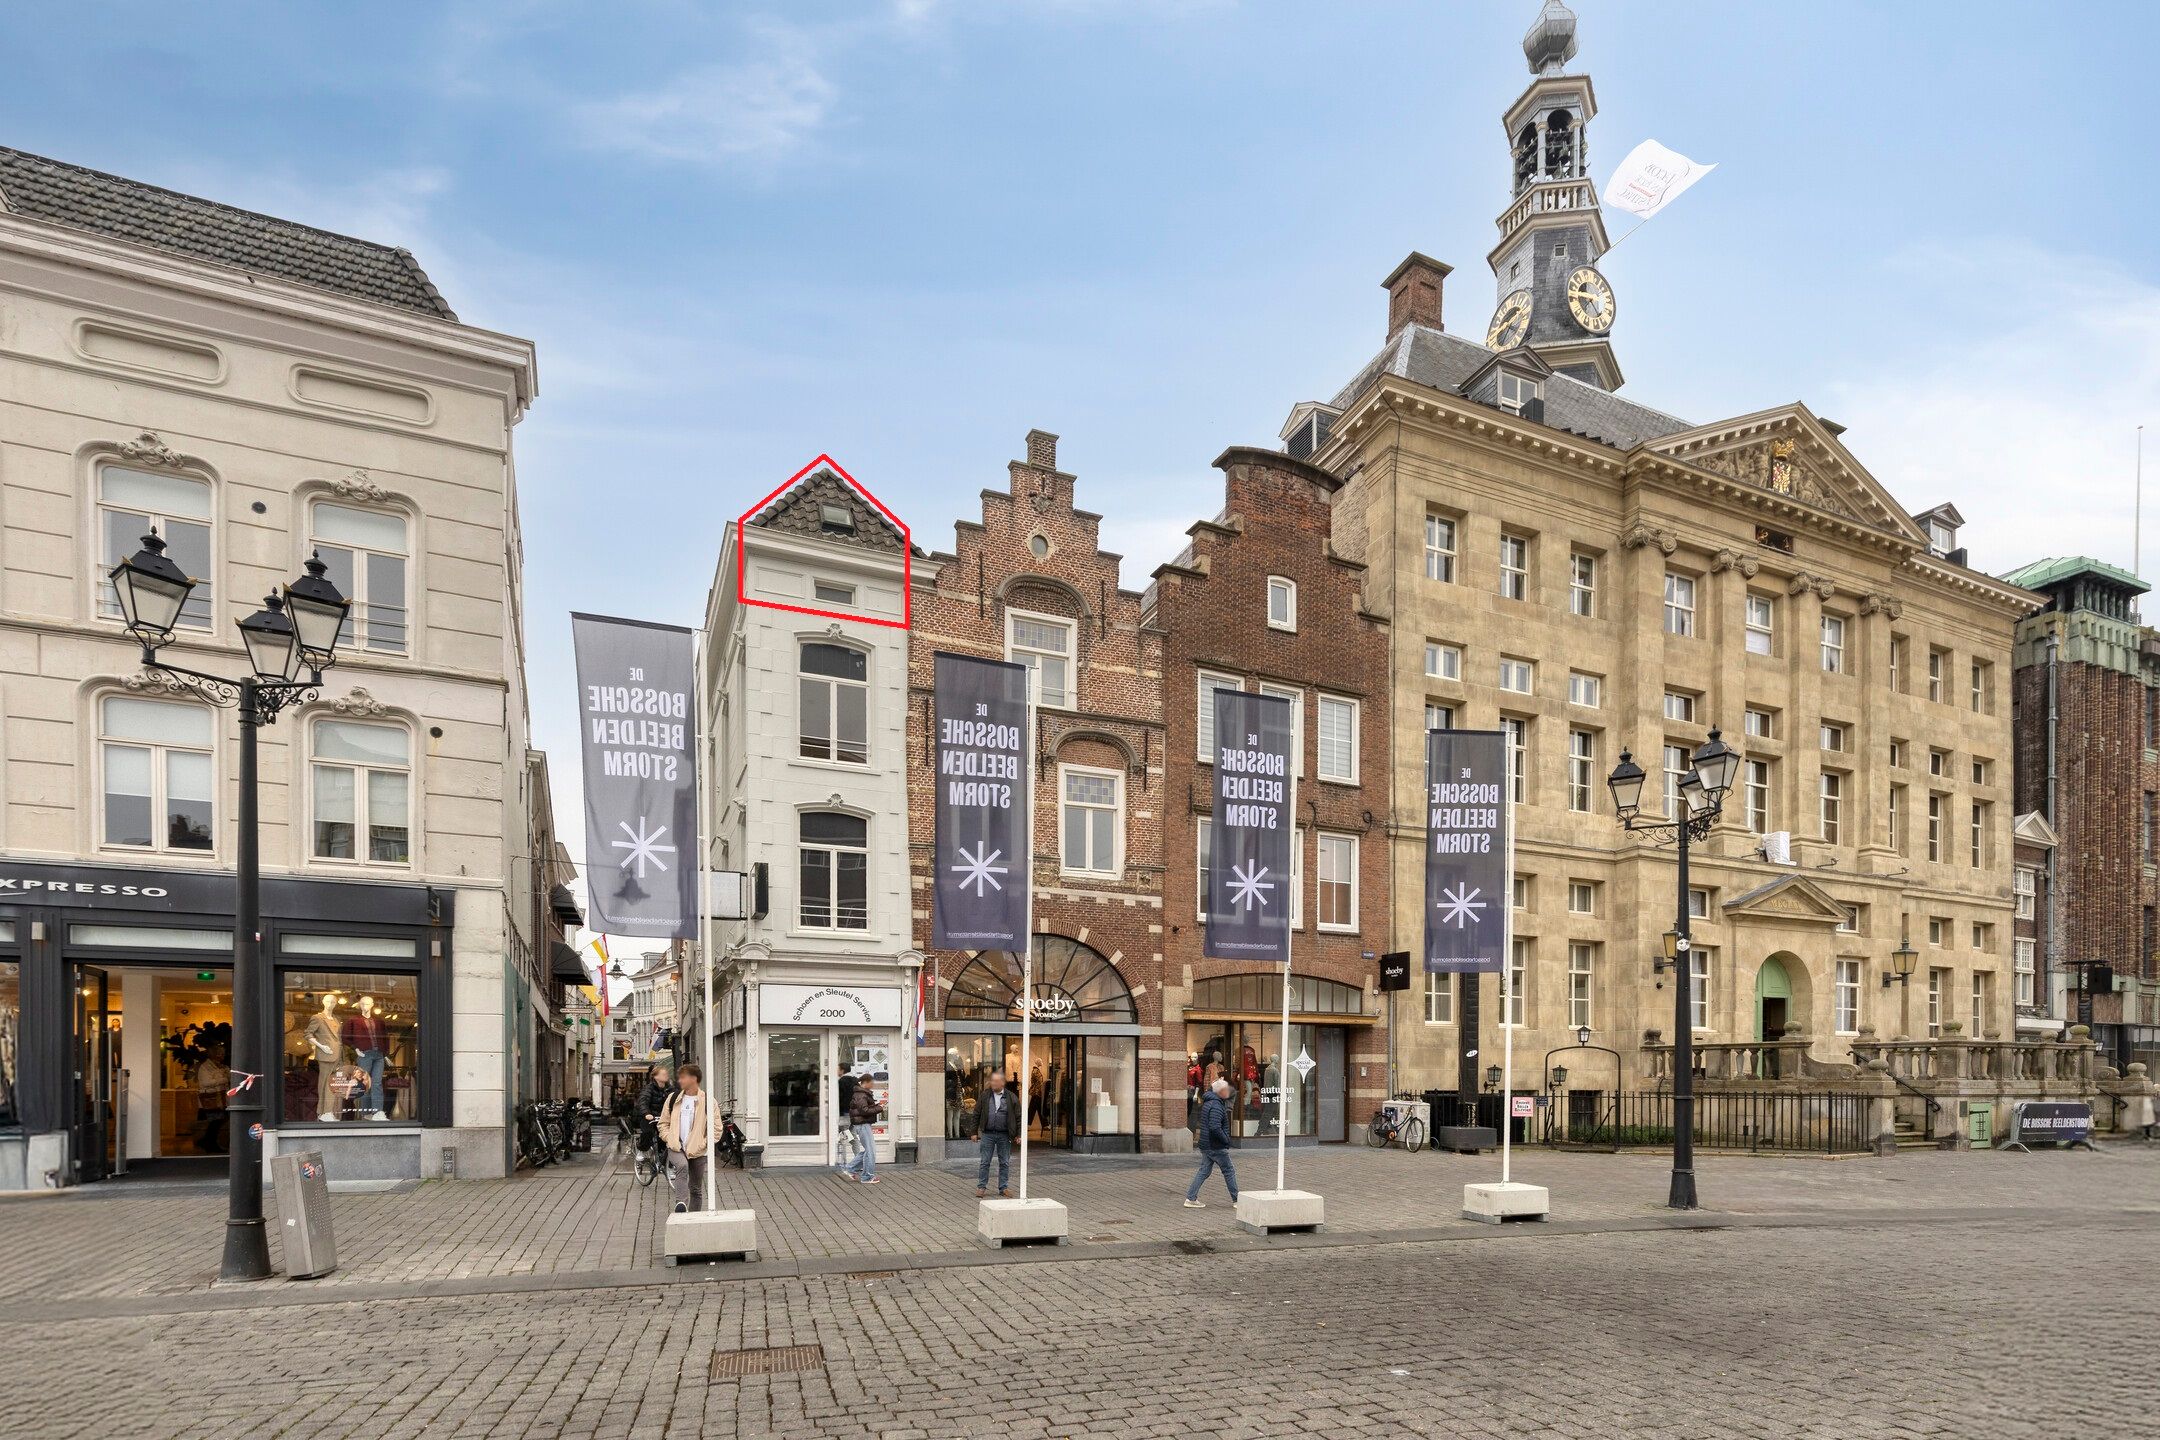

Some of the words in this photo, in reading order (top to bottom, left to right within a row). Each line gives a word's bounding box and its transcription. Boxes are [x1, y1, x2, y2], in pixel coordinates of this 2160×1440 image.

[0, 878, 168, 897] XPRESSO
[1386, 966, 1404, 975] shoeby
[793, 996, 814, 1022] Schoen
[814, 990, 825, 998] en
[826, 988, 854, 1000] Sleutel
[853, 997, 872, 1022] Service
[820, 1009, 846, 1018] 2000
[1260, 1095, 1270, 1103] in
[1272, 1095, 1292, 1104] stle
